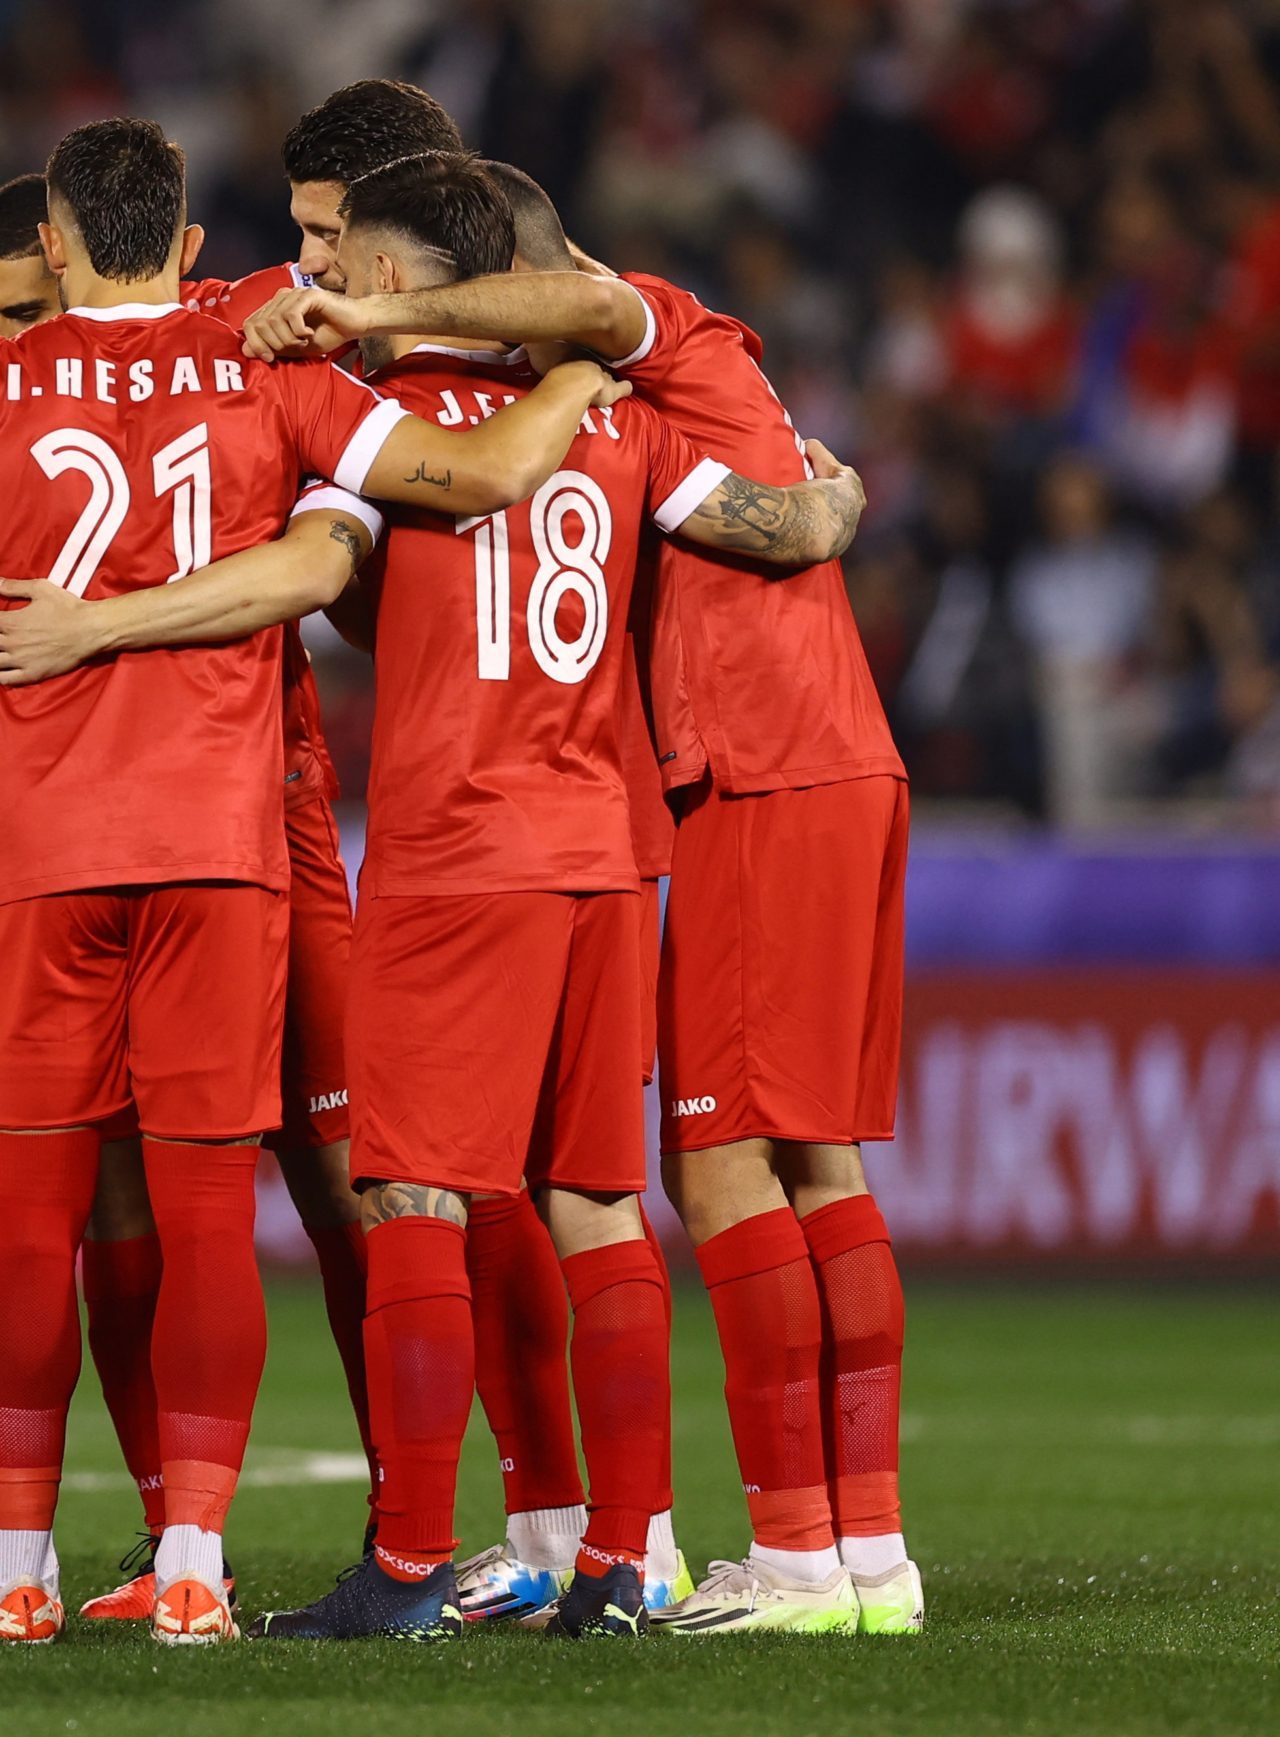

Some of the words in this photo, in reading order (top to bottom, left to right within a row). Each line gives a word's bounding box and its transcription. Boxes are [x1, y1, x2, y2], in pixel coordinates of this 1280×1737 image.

[7, 355, 246, 405] I.HESAR
[29, 420, 213, 600] 21
[455, 469, 613, 685] 18
[671, 1095, 717, 1117] JAKO
